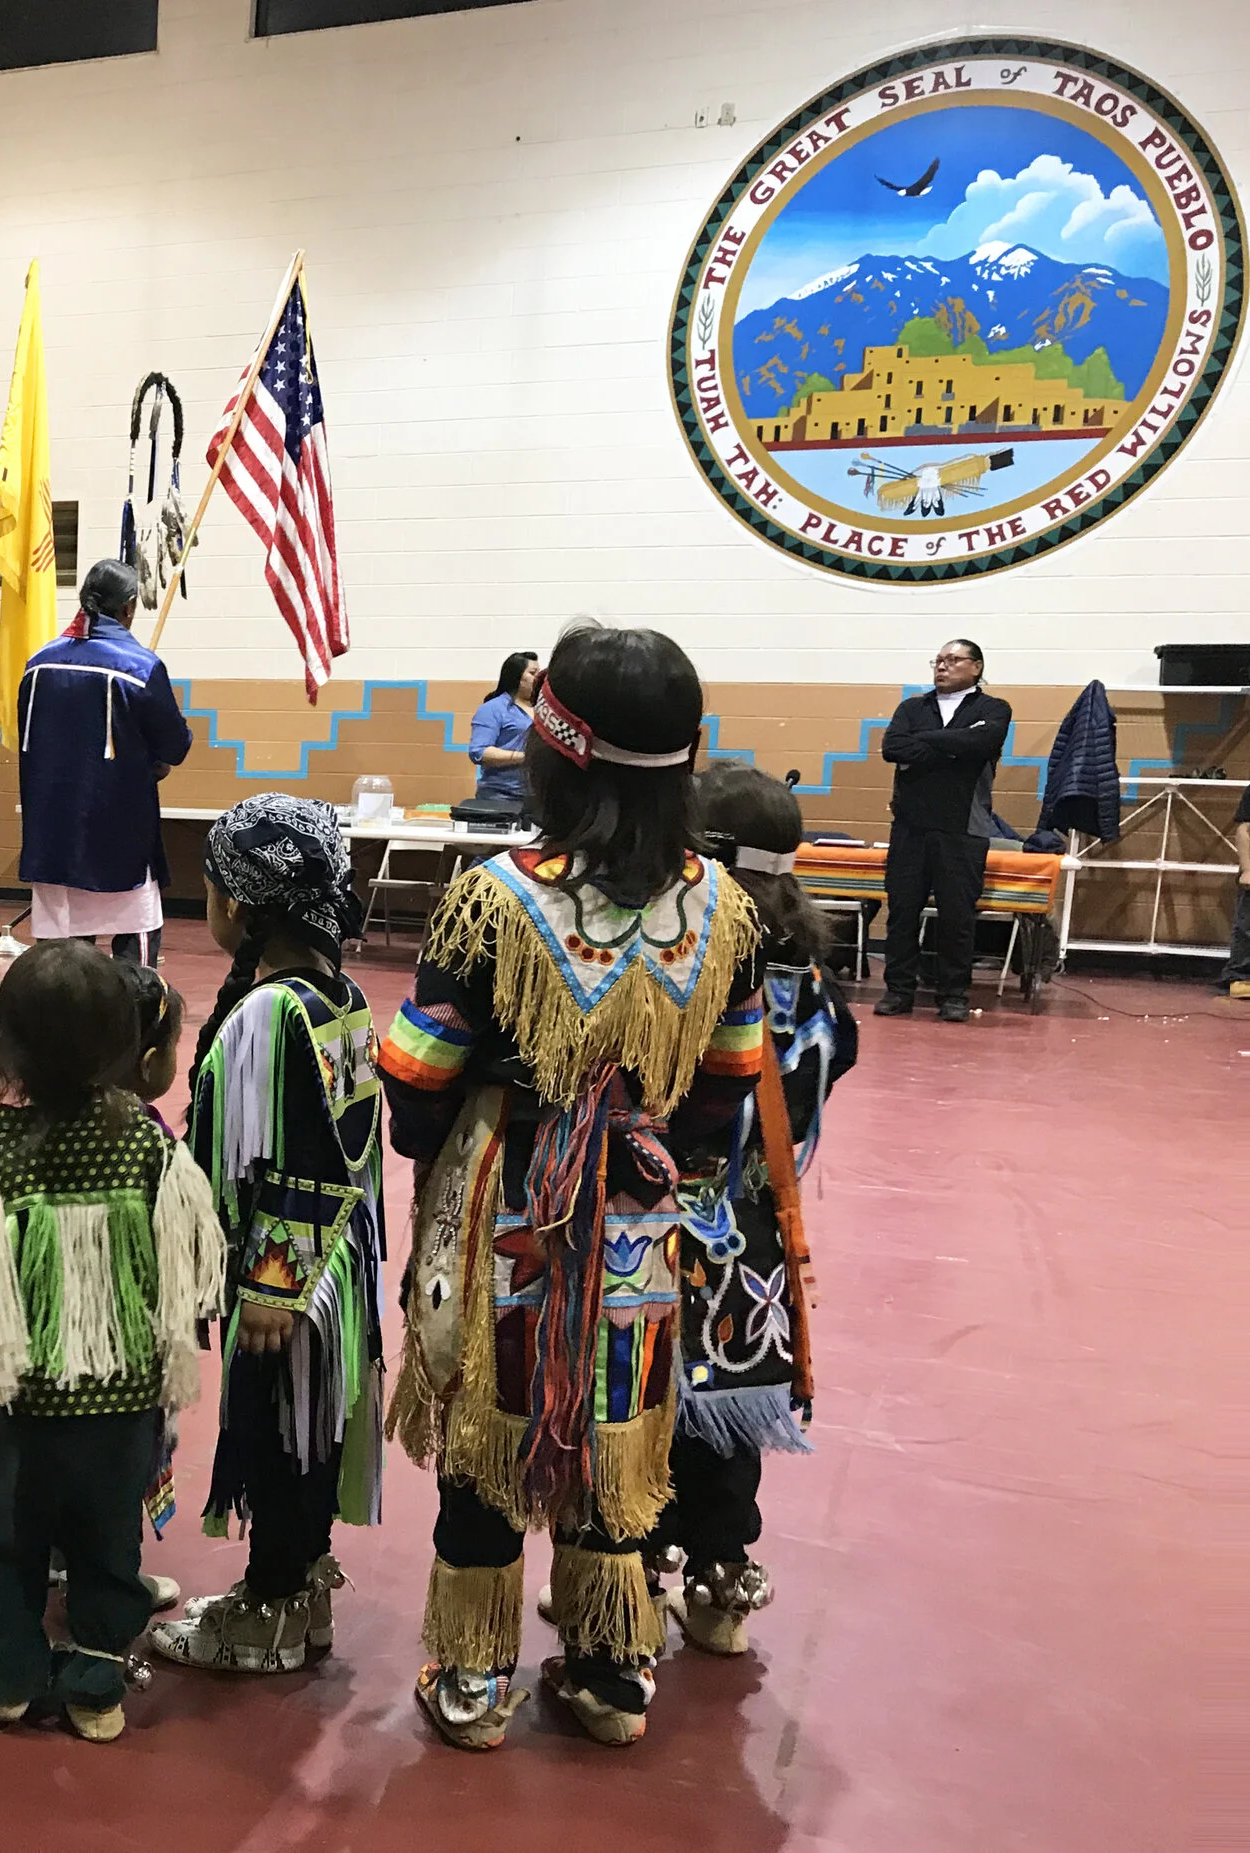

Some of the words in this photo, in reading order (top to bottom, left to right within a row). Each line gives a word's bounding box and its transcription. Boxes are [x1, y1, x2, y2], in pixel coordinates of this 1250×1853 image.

[702, 225, 746, 289] THE
[749, 106, 851, 205] GREAT
[877, 64, 972, 109] SEAL
[1000, 66, 1028, 85] of
[1052, 70, 1138, 128] TAOS
[1138, 125, 1214, 251] PUEBLO
[694, 348, 729, 434] TUAH
[724, 442, 783, 510] TAH:
[798, 512, 909, 558] PLACE
[925, 536, 947, 556] of
[958, 516, 1027, 552] THE
[1040, 468, 1112, 520] RED
[1115, 308, 1212, 458] WILLOWS
